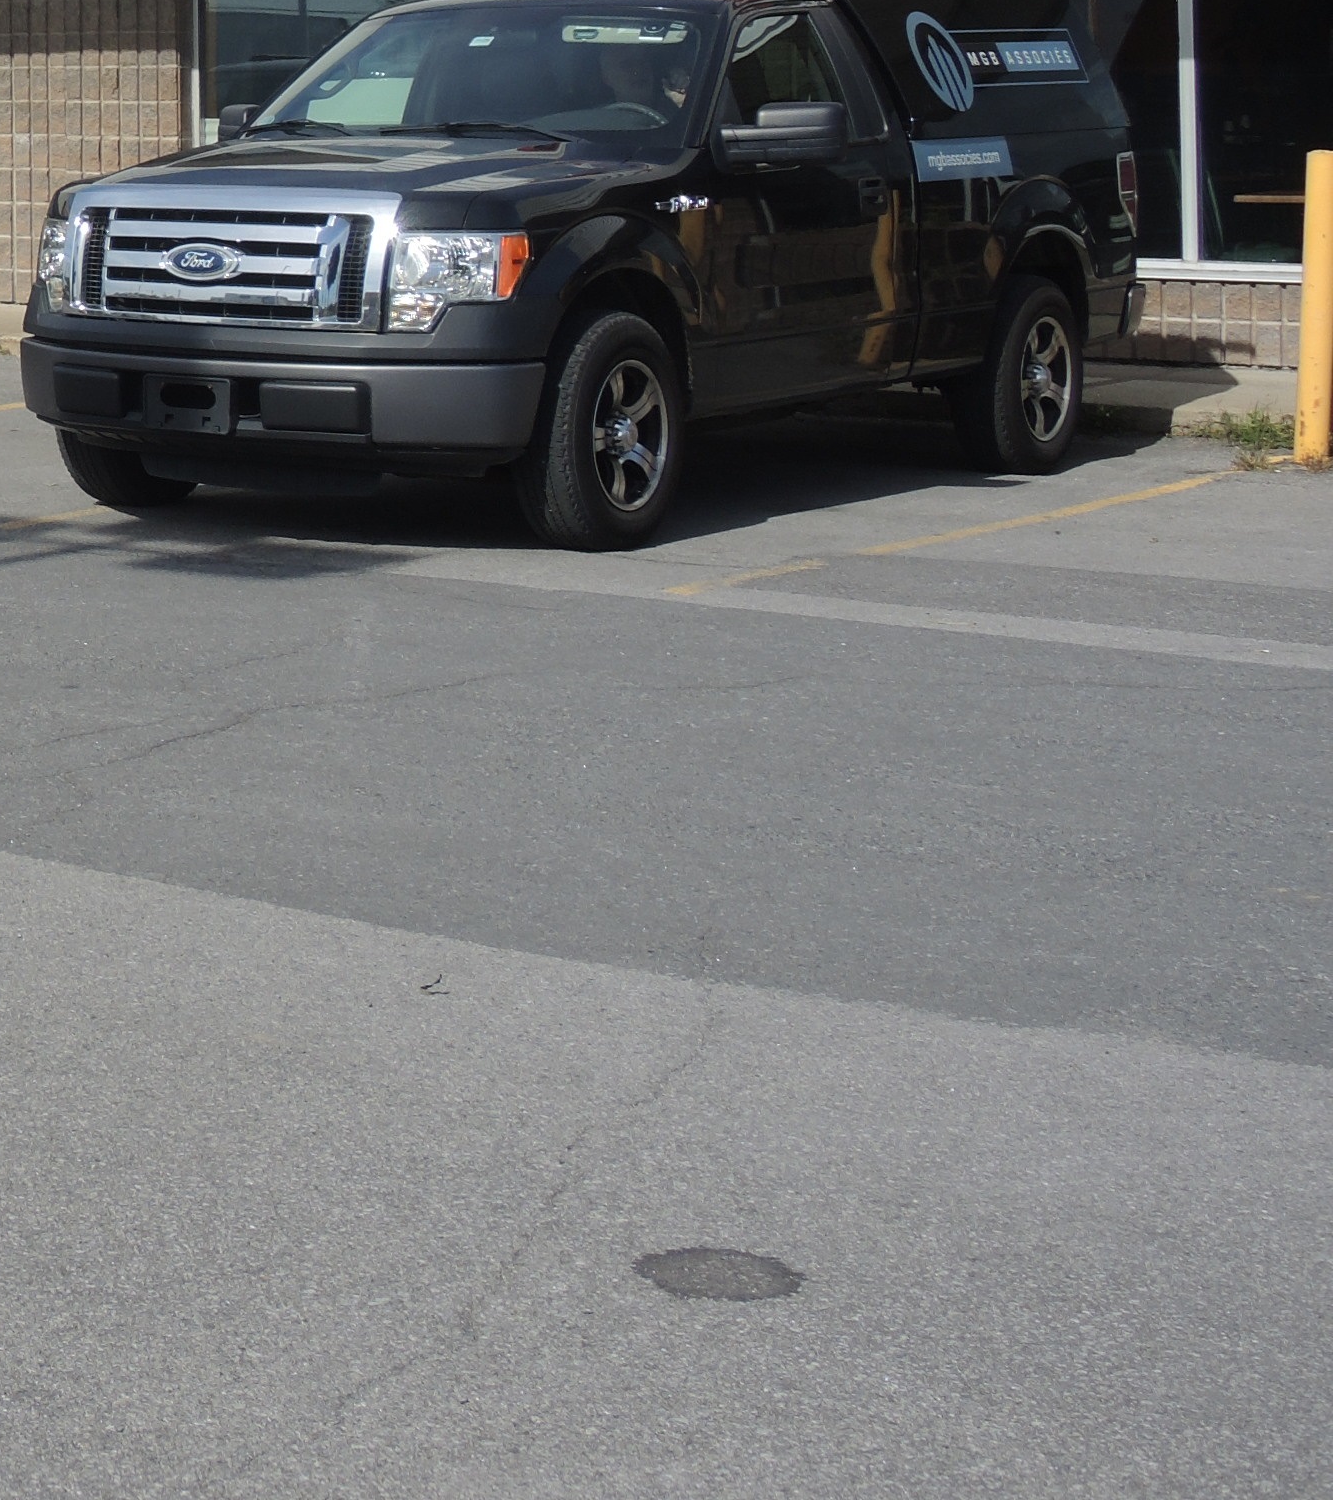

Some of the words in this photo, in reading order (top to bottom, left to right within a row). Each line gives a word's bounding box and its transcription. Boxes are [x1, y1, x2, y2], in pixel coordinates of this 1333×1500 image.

[966, 51, 1000, 67] MGB
[1005, 47, 1073, 65] ASSOCIÉS
[180, 251, 215, 268] Ford
